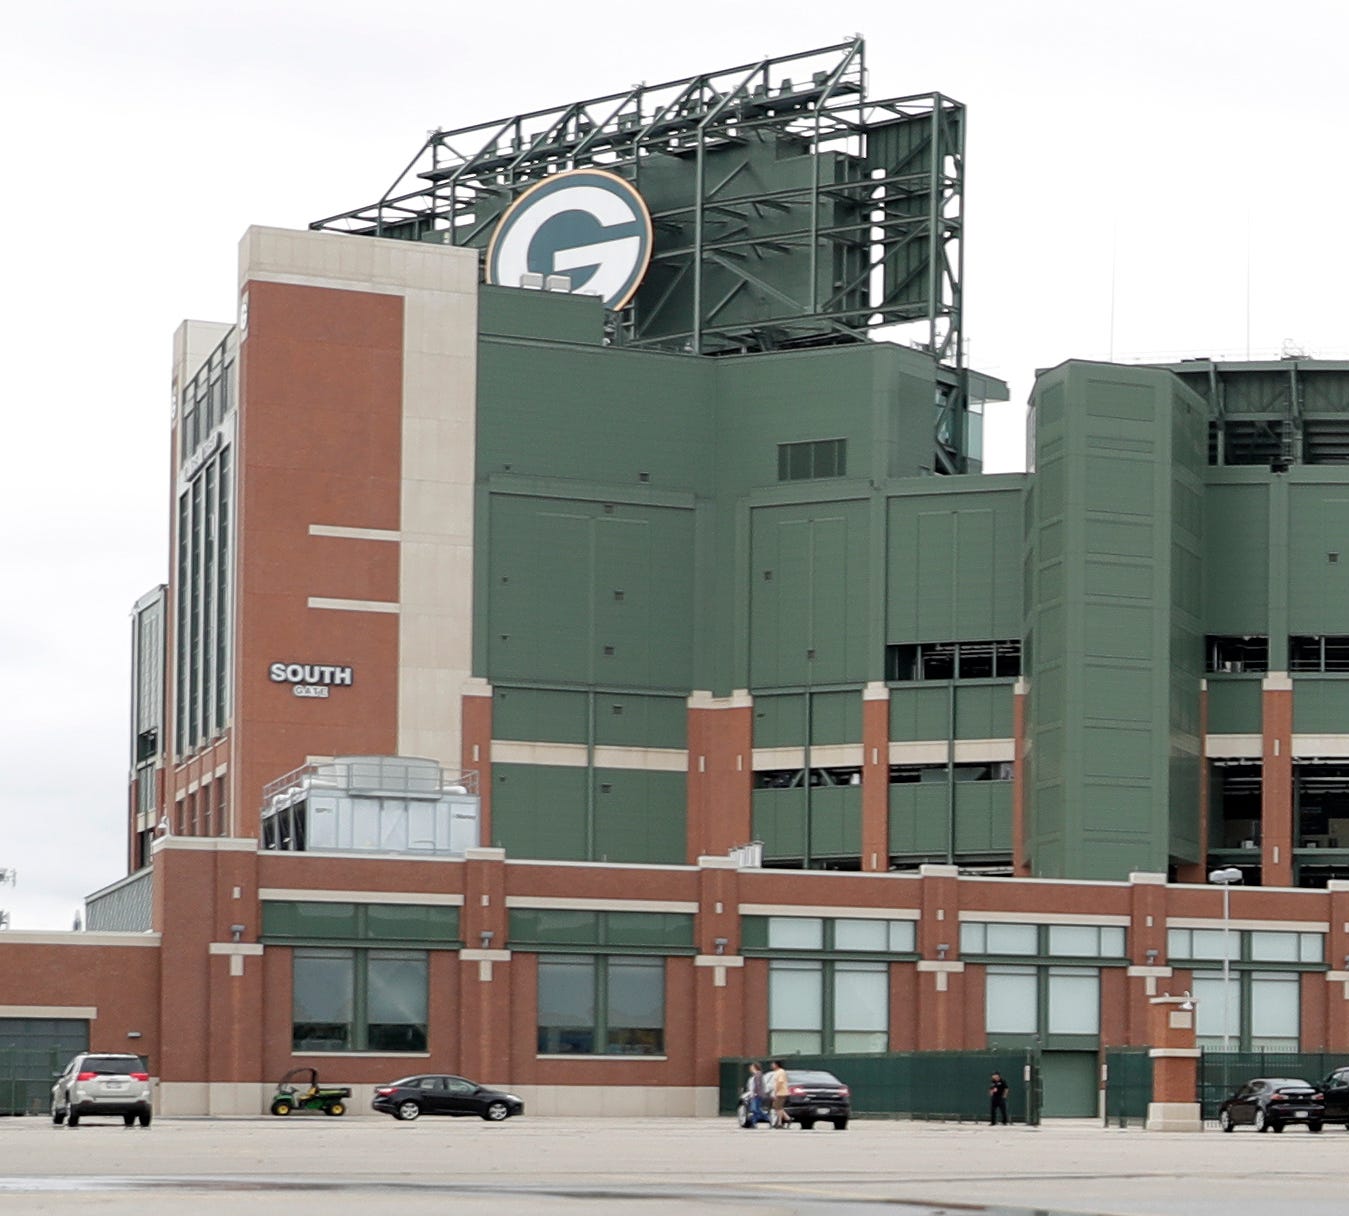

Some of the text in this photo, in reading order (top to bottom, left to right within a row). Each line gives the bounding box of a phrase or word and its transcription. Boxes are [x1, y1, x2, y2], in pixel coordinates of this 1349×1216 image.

[497, 185, 641, 304] G
[270, 663, 352, 685] SOUTH
[292, 684, 329, 698] GATE
